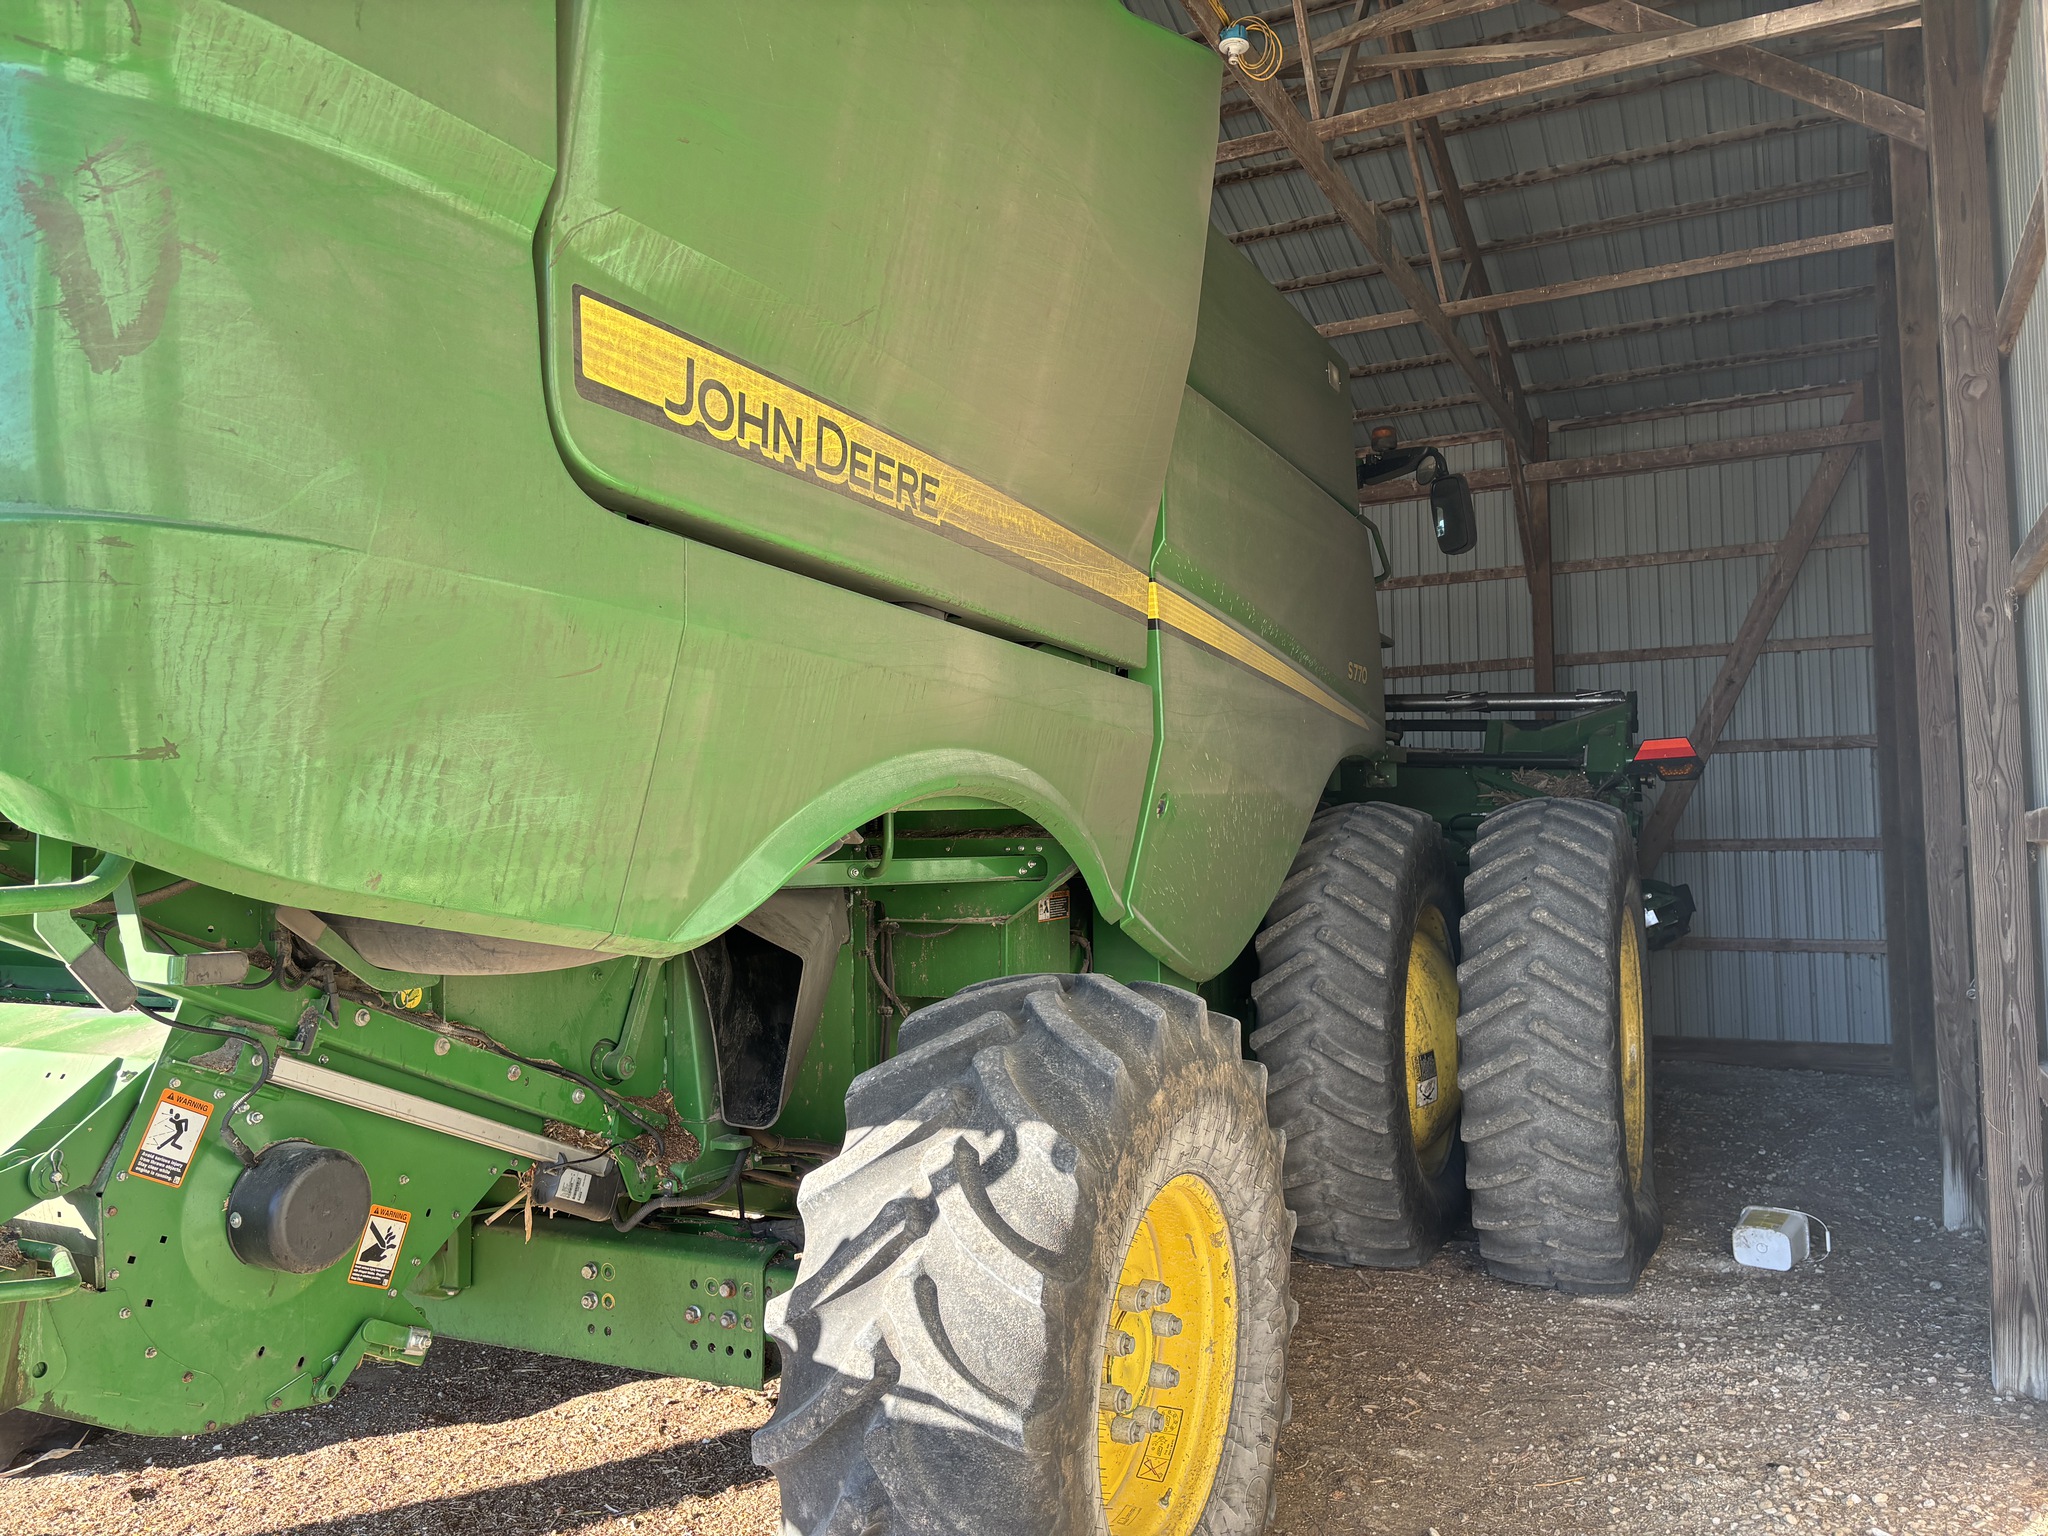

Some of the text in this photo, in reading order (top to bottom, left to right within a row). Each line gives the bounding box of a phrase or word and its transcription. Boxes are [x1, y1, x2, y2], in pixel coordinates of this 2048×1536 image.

[665, 357, 941, 519] JOHN DEERE
[1348, 661, 1368, 684] S770
[176, 1095, 208, 1112] WARNING
[137, 1160, 148, 1169] Stay
[141, 1151, 155, 1159] Avoid
[170, 1160, 183, 1168] injury
[380, 1208, 407, 1221] WARNING
